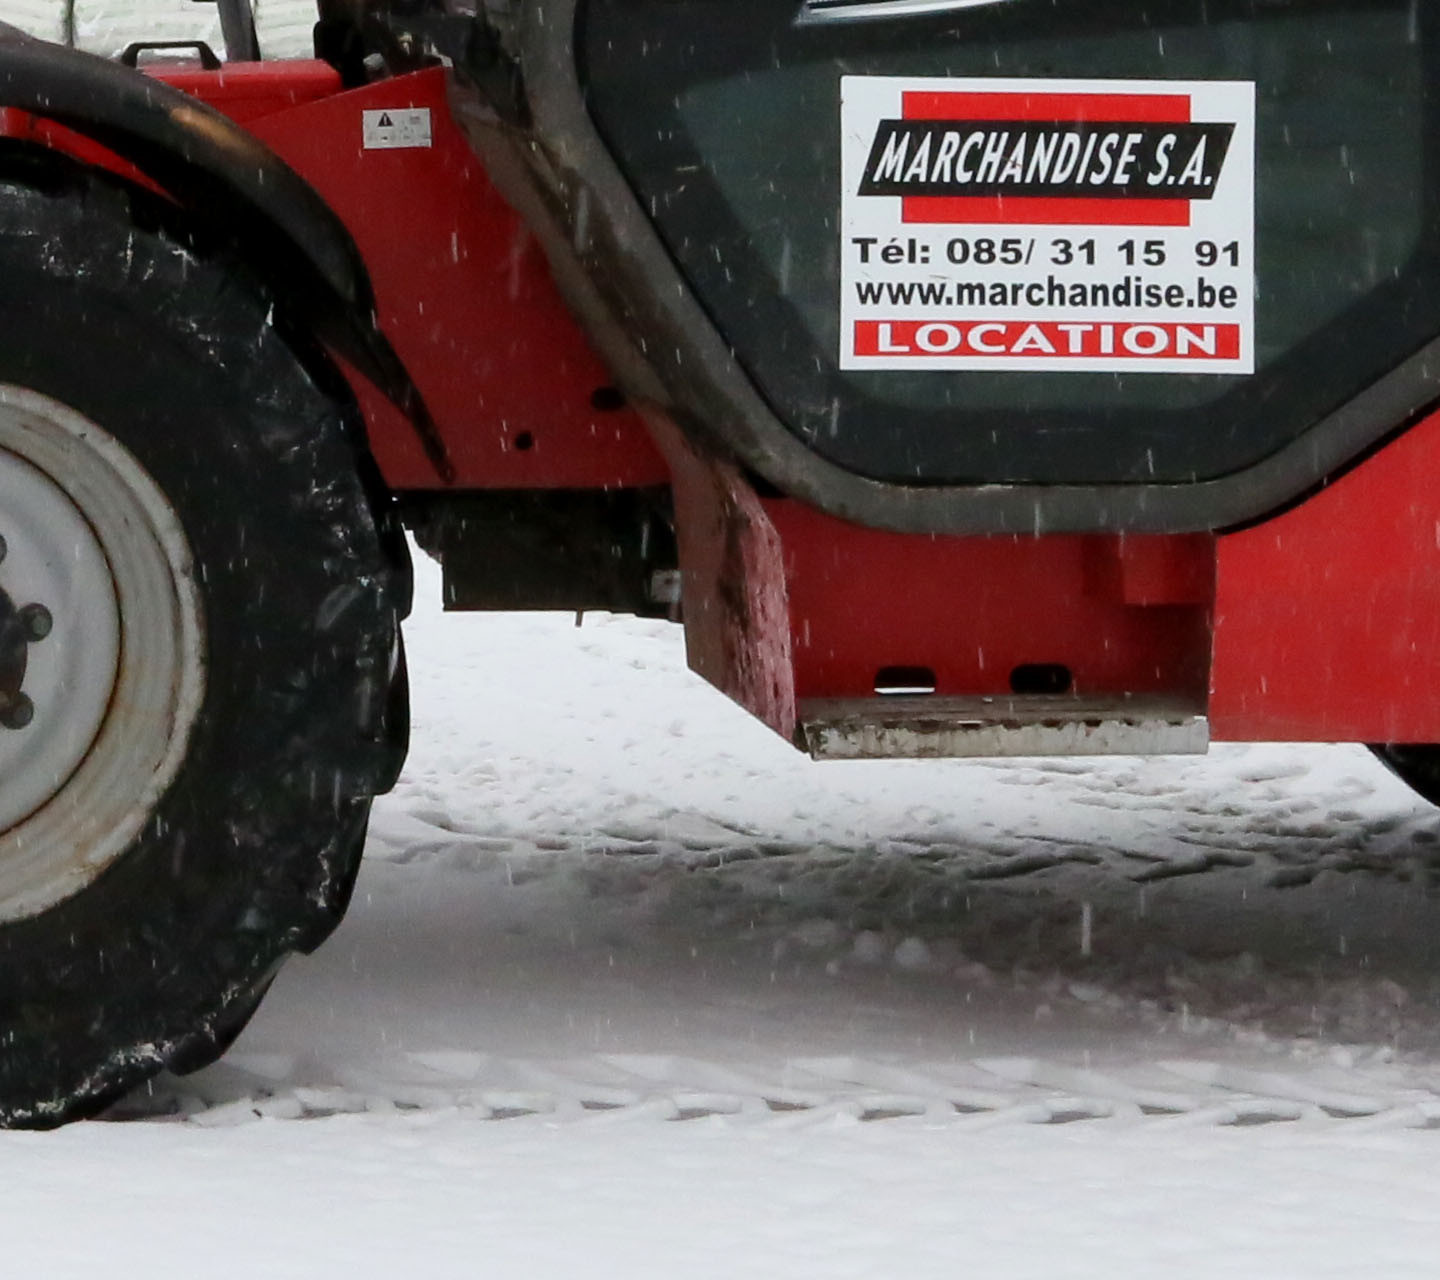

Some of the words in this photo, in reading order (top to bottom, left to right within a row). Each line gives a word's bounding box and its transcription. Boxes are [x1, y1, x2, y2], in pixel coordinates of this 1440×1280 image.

[872, 130, 1142, 185] MARCHANDISE
[1146, 133, 1213, 187] S.A.
[852, 237, 930, 265] Tél:
[946, 238, 1035, 266] 085/
[1051, 239, 1095, 265] 31
[1118, 240, 1167, 266] 15
[1194, 241, 1240, 267] 91
[856, 275, 1238, 309] www.marchandise.be
[878, 323, 1216, 355] LOCATION
